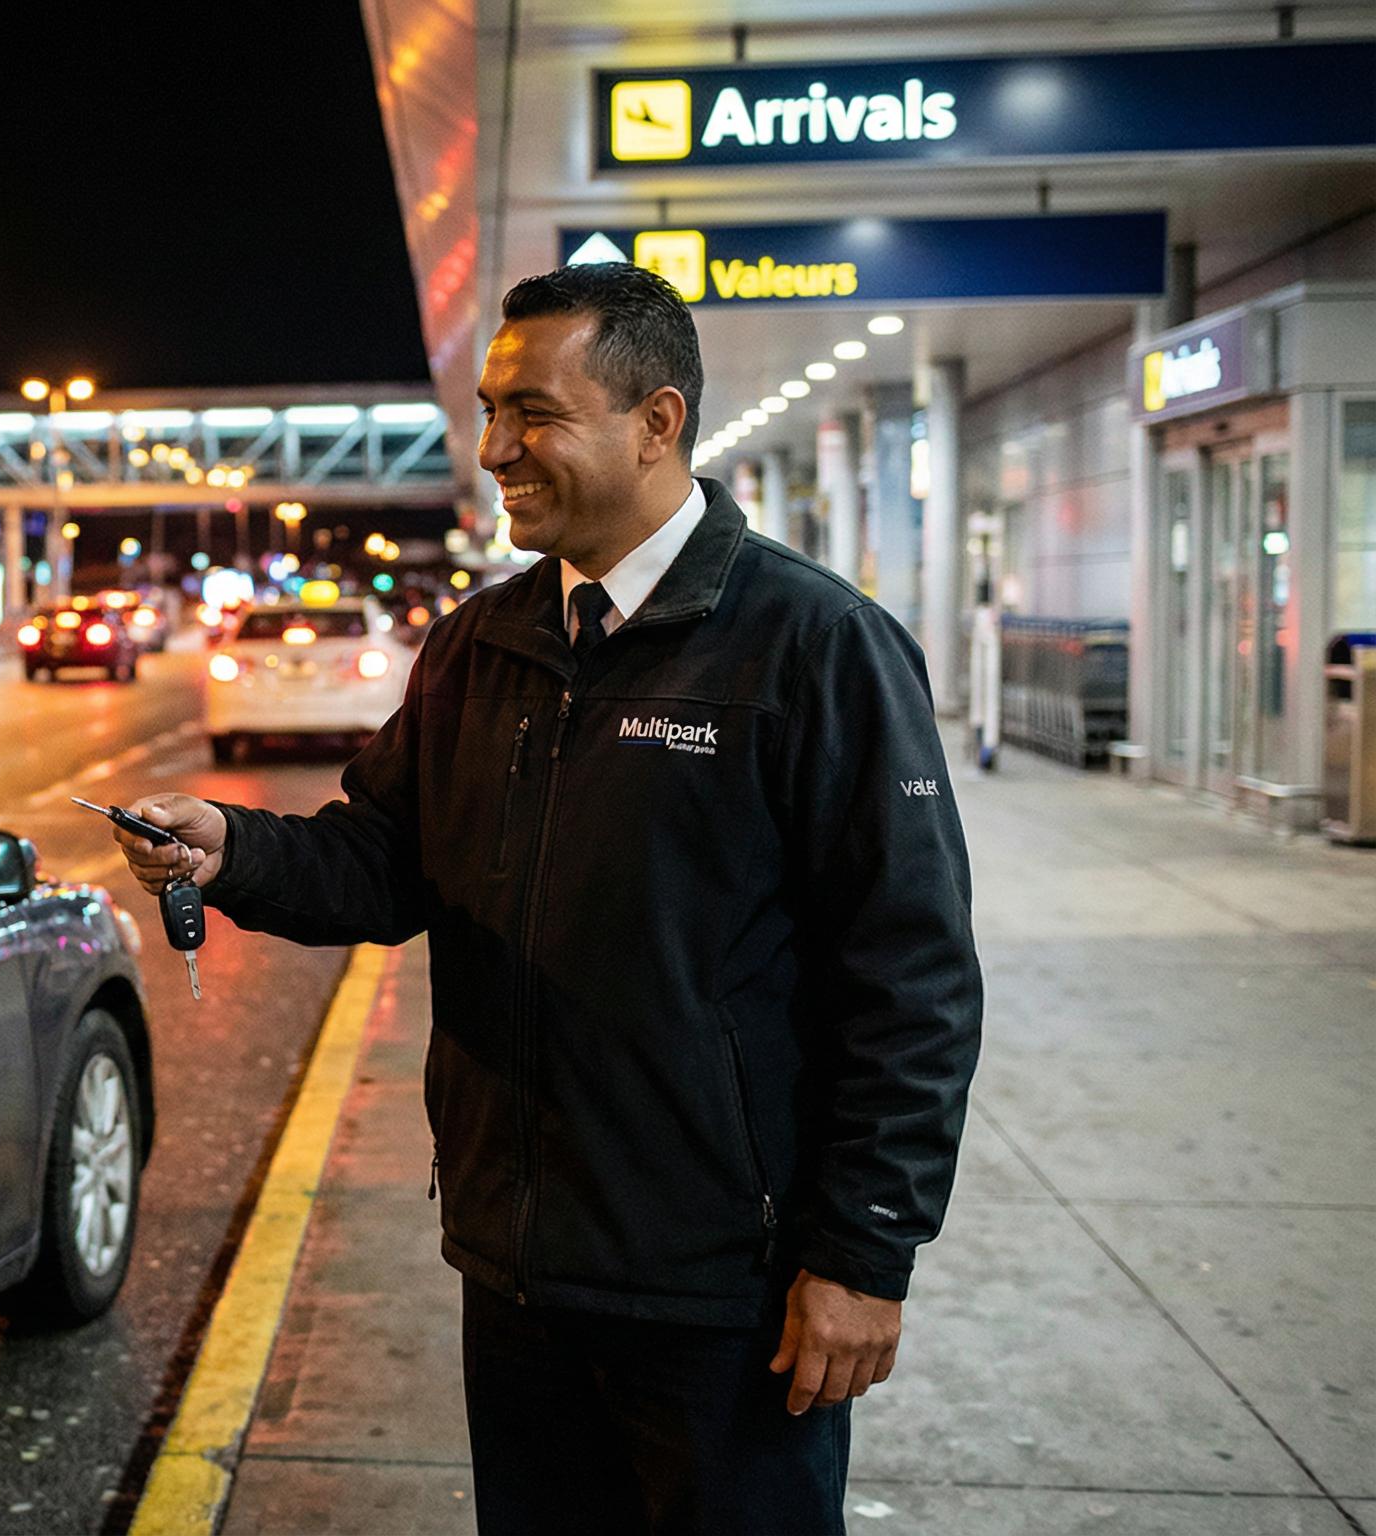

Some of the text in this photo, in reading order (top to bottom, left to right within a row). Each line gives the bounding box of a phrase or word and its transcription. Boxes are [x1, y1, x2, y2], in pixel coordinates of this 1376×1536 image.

[701, 78, 957, 147] Arrivals
[709, 256, 858, 299] Valeurs
[619, 717, 719, 746] Multipark
